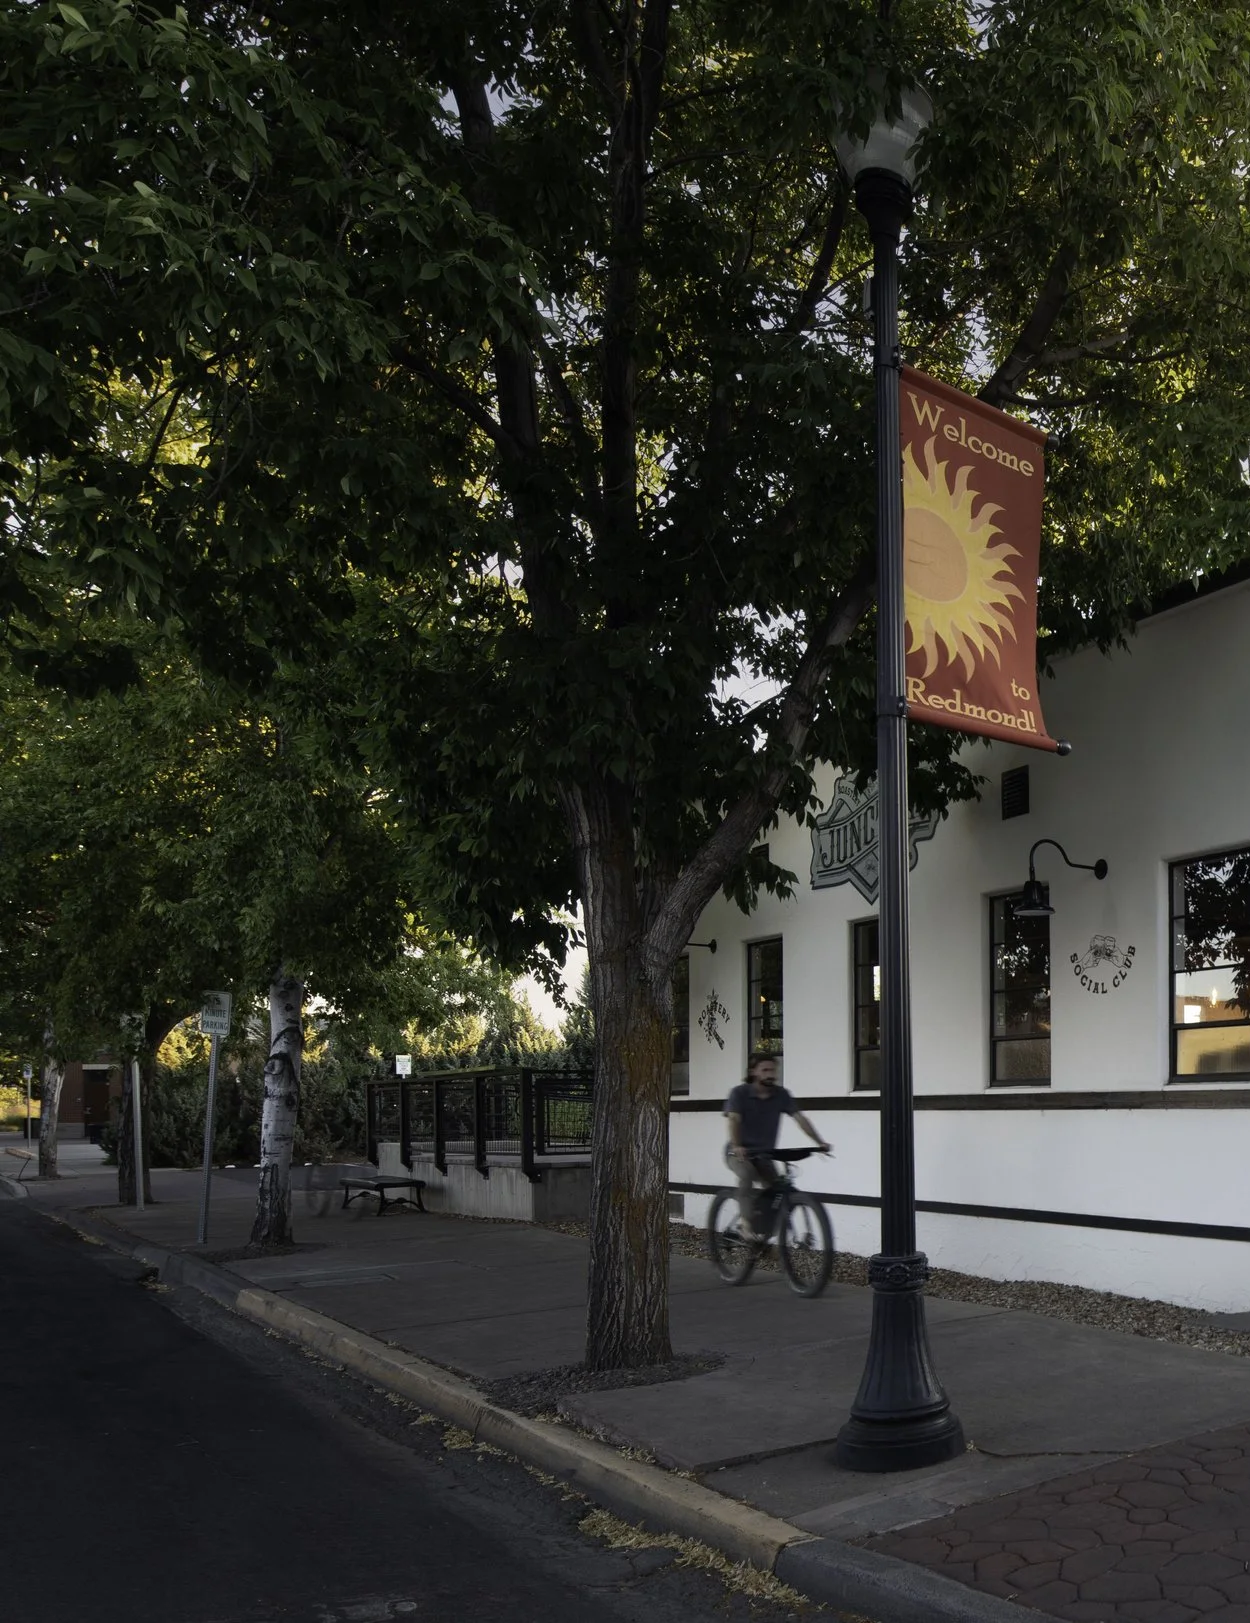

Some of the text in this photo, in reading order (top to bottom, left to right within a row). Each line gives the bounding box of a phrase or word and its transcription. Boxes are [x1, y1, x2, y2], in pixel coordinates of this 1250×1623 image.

[906, 391, 1036, 478] Welcome
[905, 676, 1037, 733] Redmond!
[1010, 679, 1031, 701] to
[1070, 945, 1137, 994] SOCIAL CLUB
